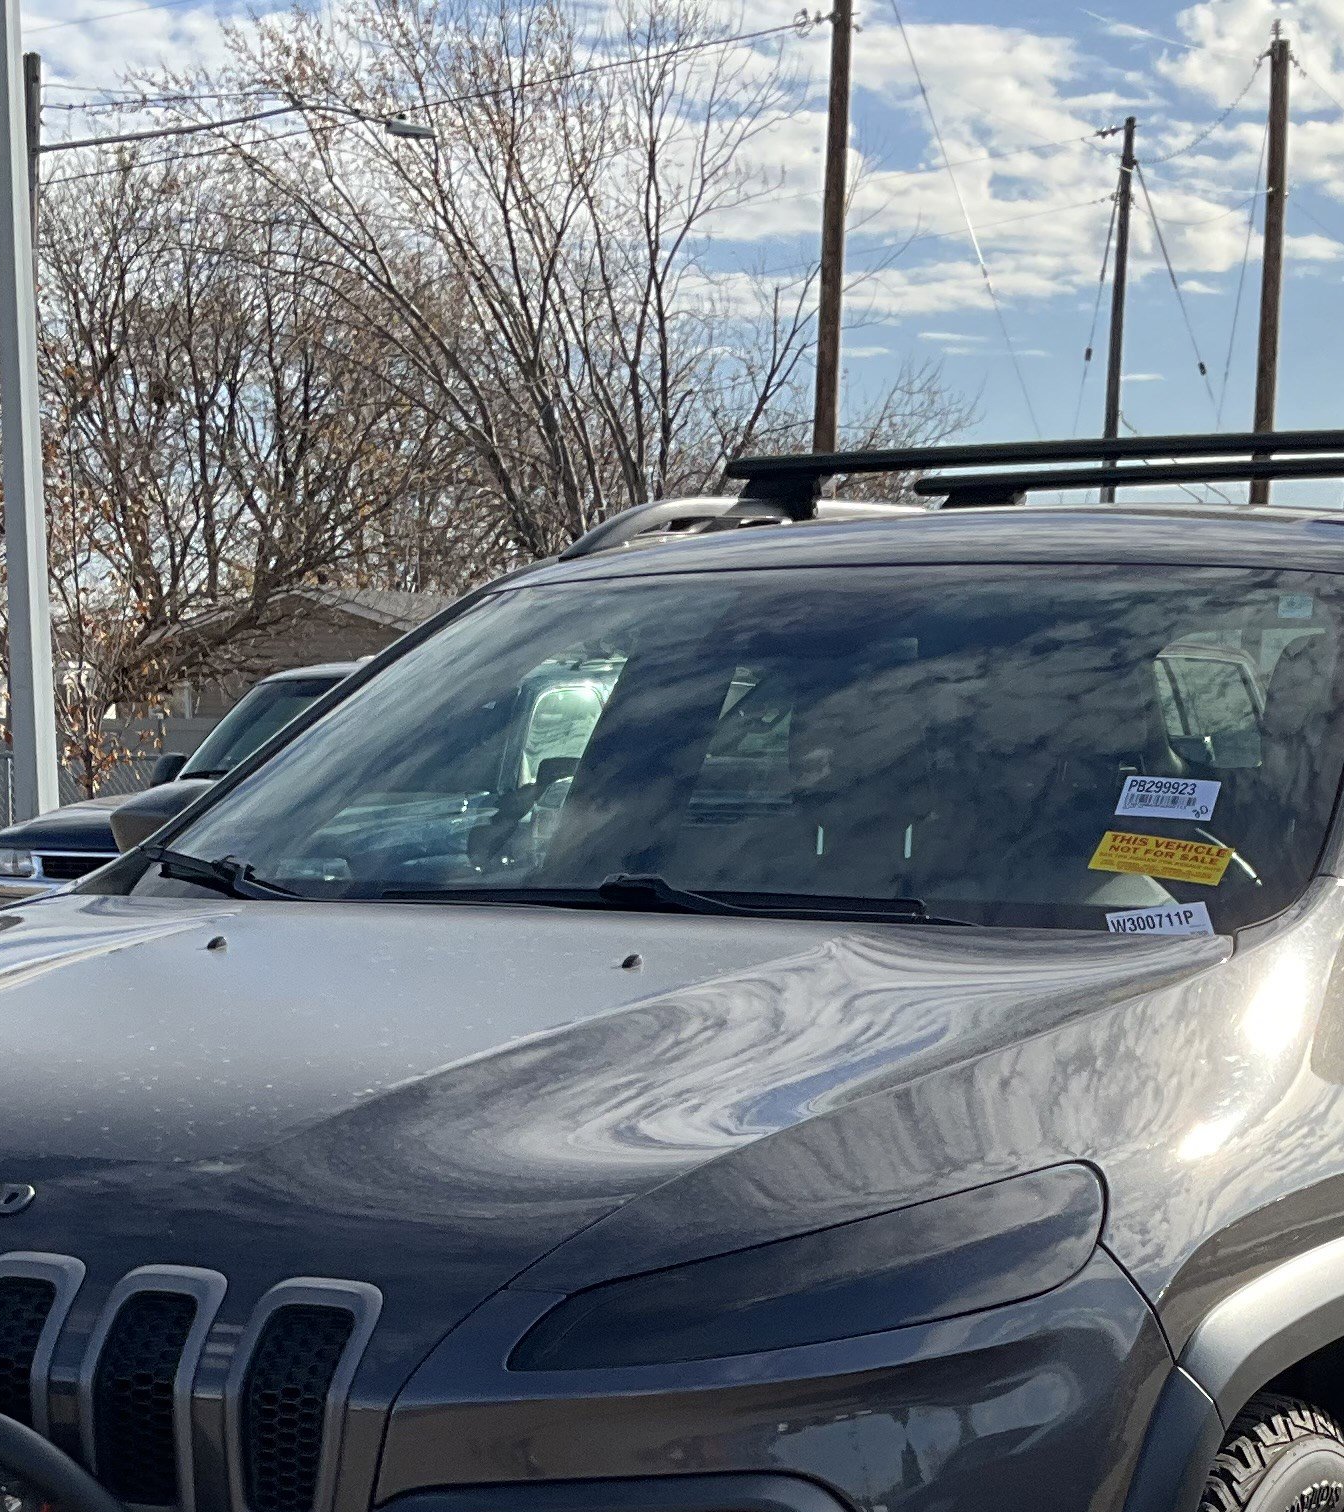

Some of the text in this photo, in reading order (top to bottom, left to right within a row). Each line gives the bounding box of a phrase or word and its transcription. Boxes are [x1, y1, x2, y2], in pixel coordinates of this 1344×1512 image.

[1127, 779, 1197, 796] PB299923
[1108, 844, 1221, 866] NOT FOR SALE
[1110, 834, 1229, 858] THIS VEHICLE
[1110, 910, 1194, 933] W300711P
